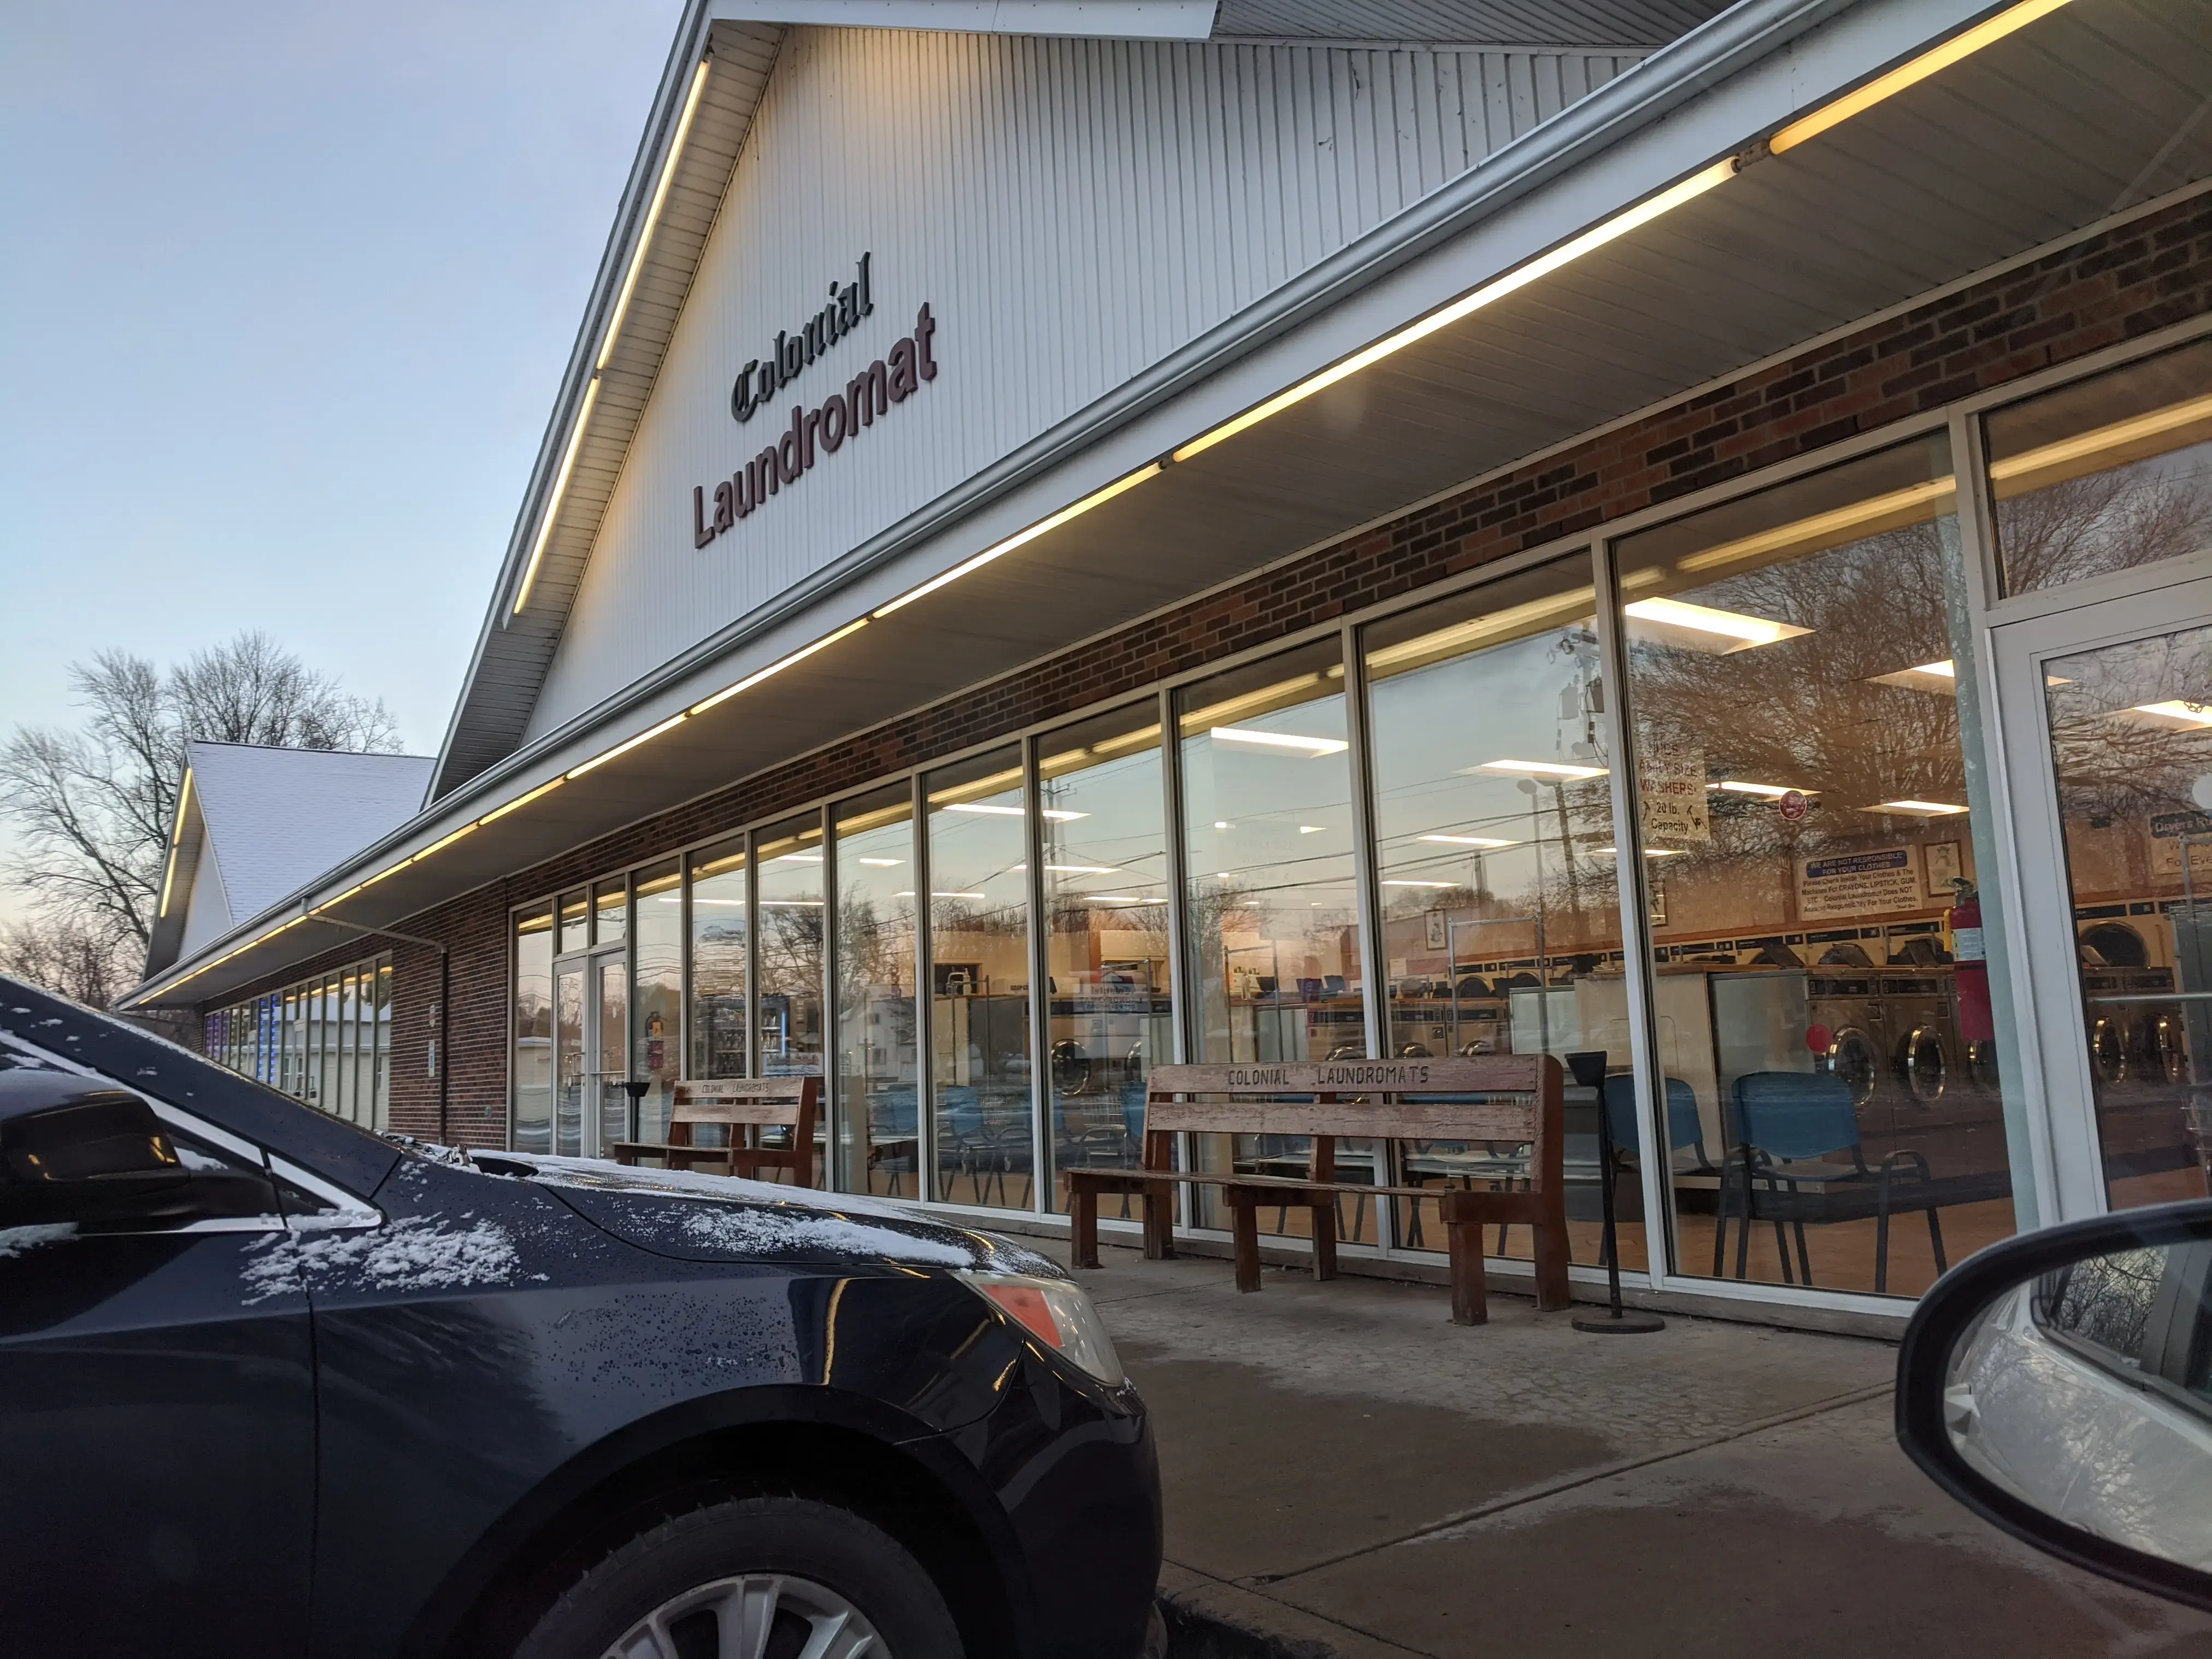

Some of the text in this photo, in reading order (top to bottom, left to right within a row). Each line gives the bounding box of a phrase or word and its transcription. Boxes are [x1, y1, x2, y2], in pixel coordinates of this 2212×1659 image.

[731, 251, 873, 422] Colonial
[693, 302, 937, 549] Laundromat
[1656, 802, 1667, 814] 20
[1651, 818, 1688, 835] Capacity
[1853, 852, 1903, 863] RESPONSIBLE
[1838, 865, 1857, 874] YOUR
[1858, 861, 1891, 872] CLOTHES
[1824, 894, 1847, 902] Colonial
[1848, 890, 1881, 900] Laundromat
[1228, 1066, 1429, 1086] COLONIAL LAUNDROMATS
